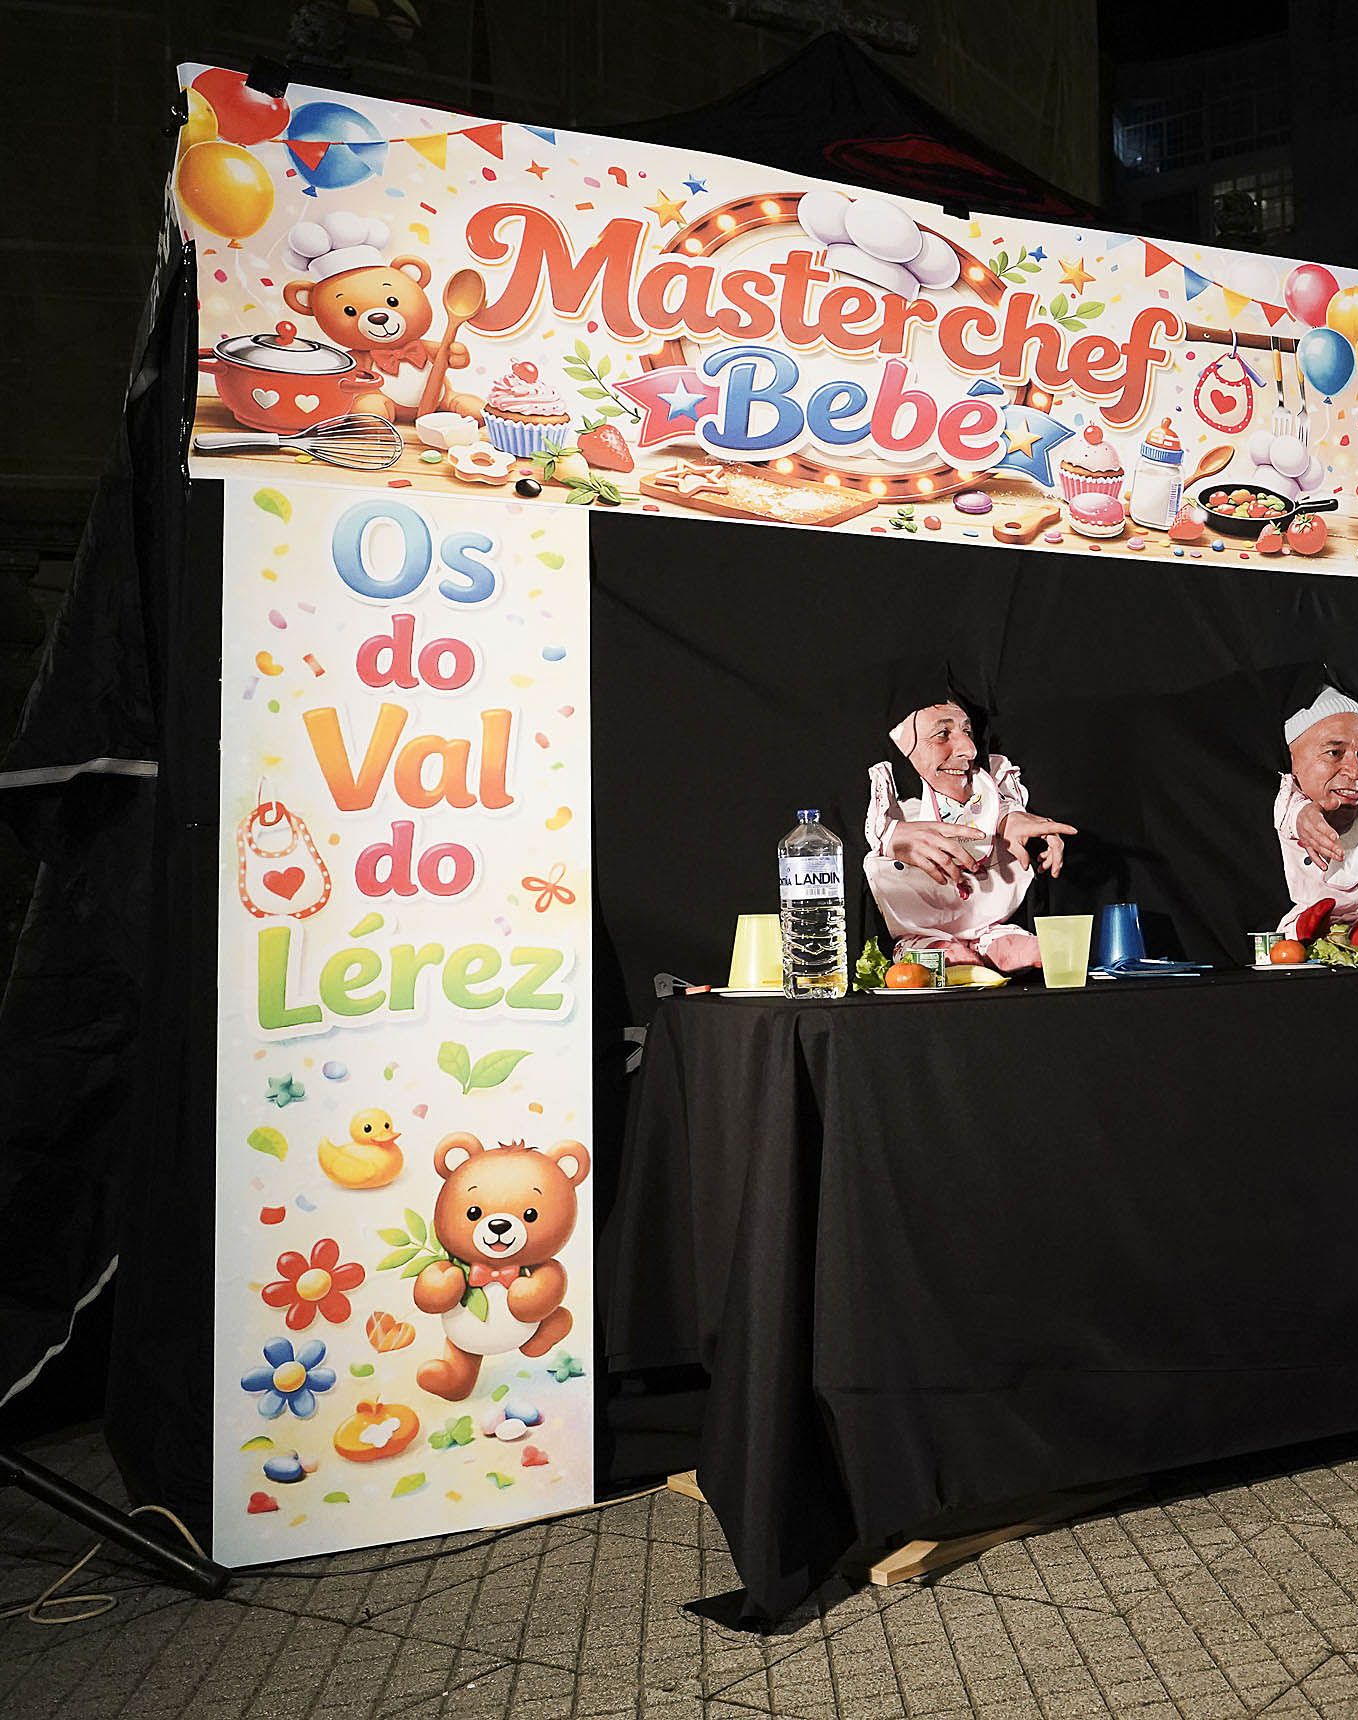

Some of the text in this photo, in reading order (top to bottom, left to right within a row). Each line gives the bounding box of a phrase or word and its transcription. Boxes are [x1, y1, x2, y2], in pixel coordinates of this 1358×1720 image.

[702, 345, 1000, 460] Bebé
[332, 499, 496, 604] Os
[355, 613, 476, 691] do
[302, 702, 515, 813] Val
[354, 820, 476, 897] do
[257, 911, 565, 1030] Lérez
